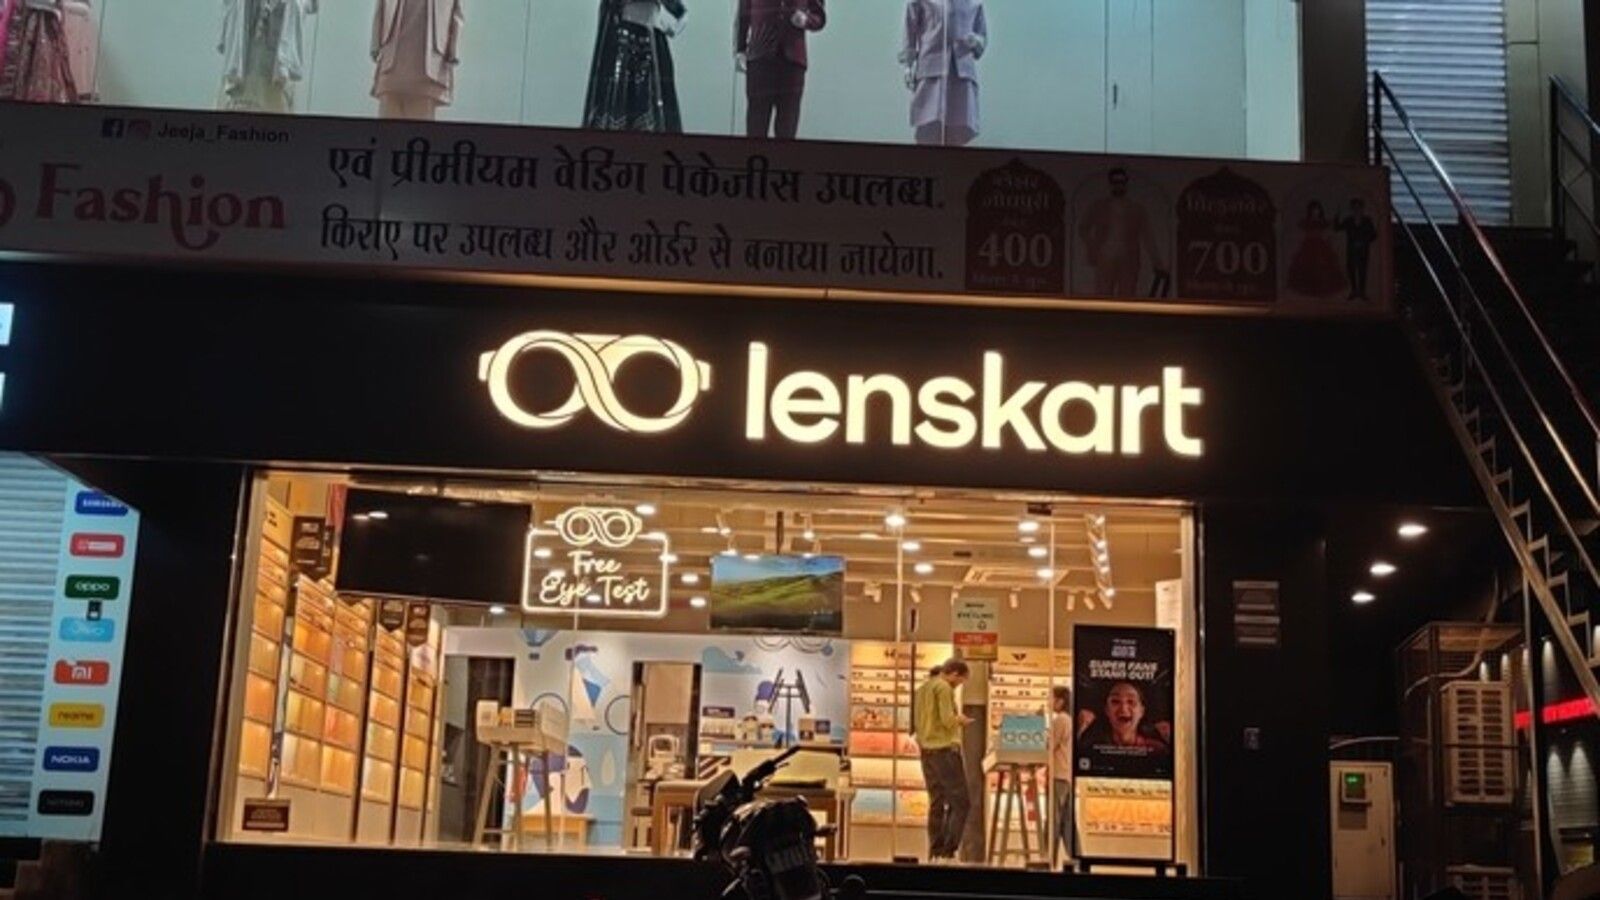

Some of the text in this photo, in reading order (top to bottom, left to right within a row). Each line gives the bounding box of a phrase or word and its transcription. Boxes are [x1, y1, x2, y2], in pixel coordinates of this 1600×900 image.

[157, 122, 290, 143] Jeeja_Fashion
[328, 137, 377, 188] एवं
[36, 162, 287, 250] Fashion
[321, 203, 402, 261] किराए
[413, 222, 449, 254] पर
[460, 223, 553, 260] उपलब्ध
[565, 215, 617, 262] और
[709, 222, 732, 270] से
[744, 239, 829, 273] बनाया
[977, 232, 1053, 268] 400
[1187, 240, 1268, 280] 700
[745, 341, 1205, 455] lenskart
[567, 551, 622, 576] Free
[540, 573, 651, 606] Eye Test
[51, 754, 91, 765] NOKIA
